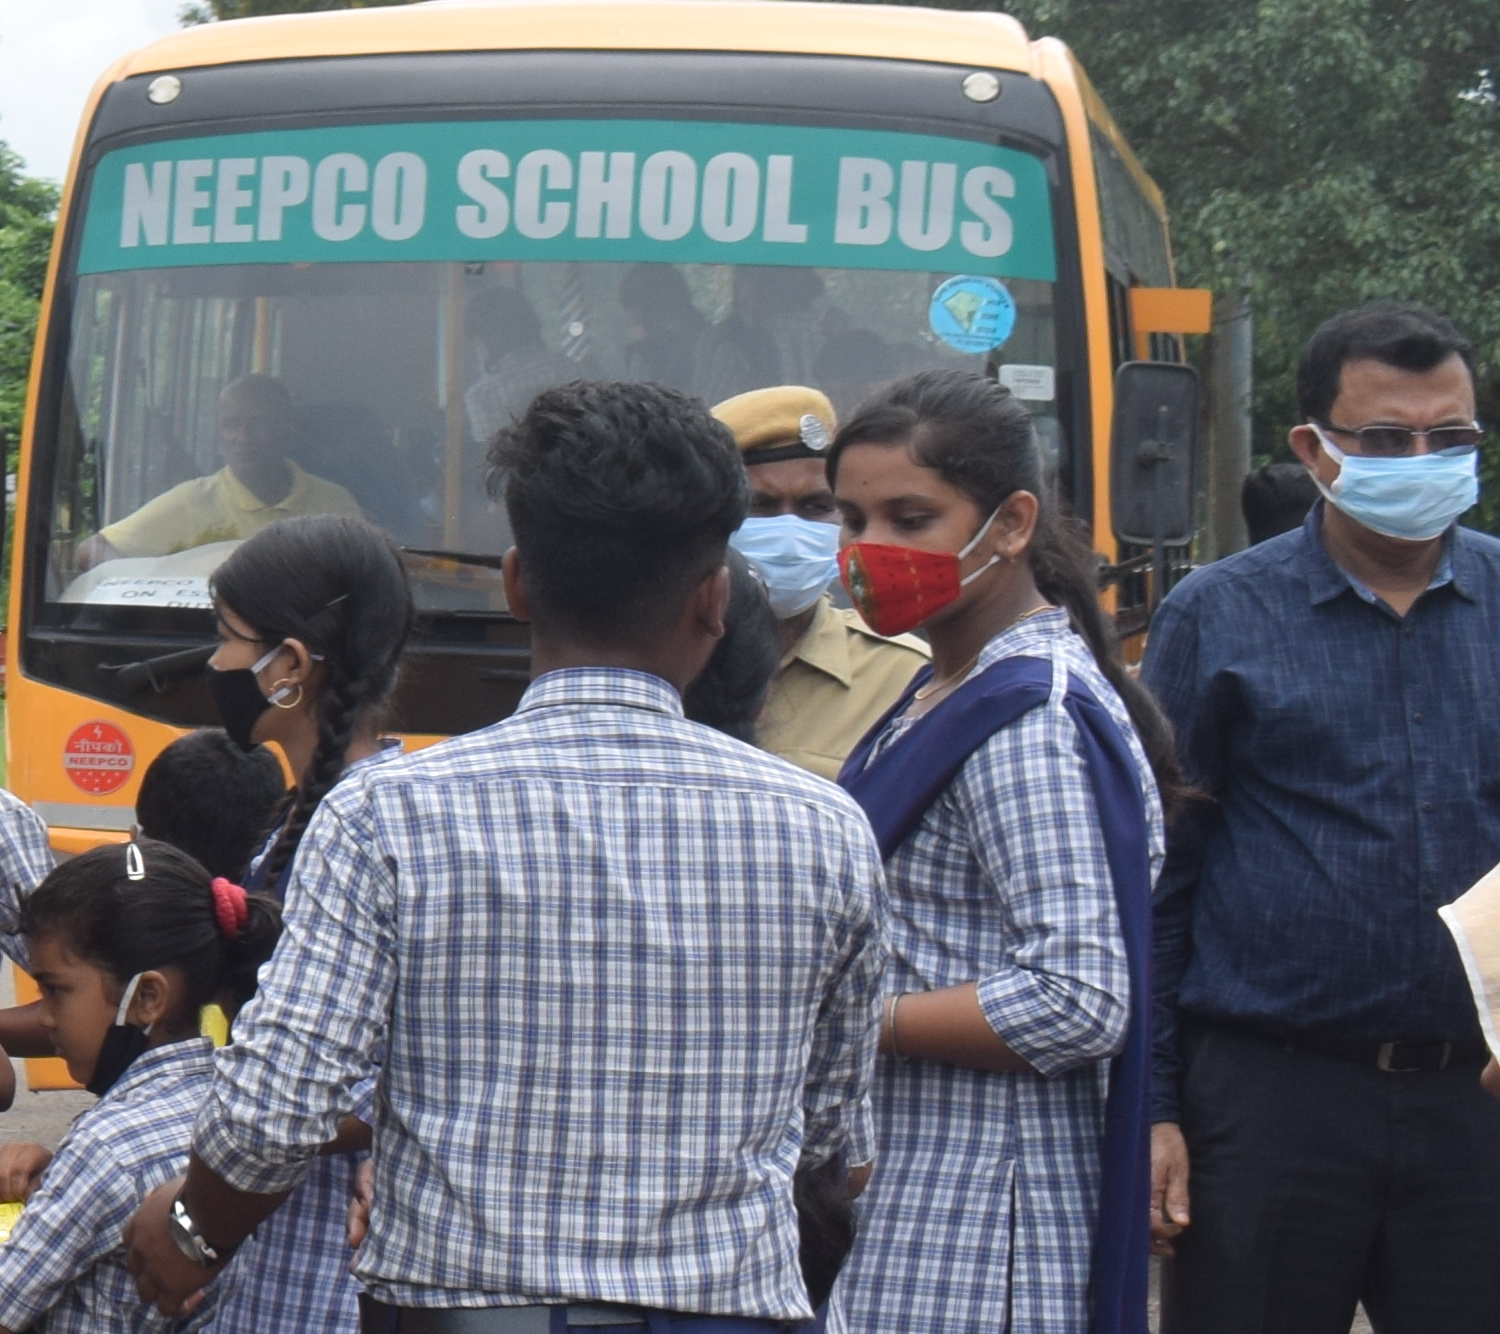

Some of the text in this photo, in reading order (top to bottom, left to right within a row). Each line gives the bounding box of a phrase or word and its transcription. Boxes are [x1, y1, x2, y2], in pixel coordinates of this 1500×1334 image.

[119, 148, 1016, 258] NEEPCO SCHOOL BUS
[69, 756, 128, 767] NEEPCO
